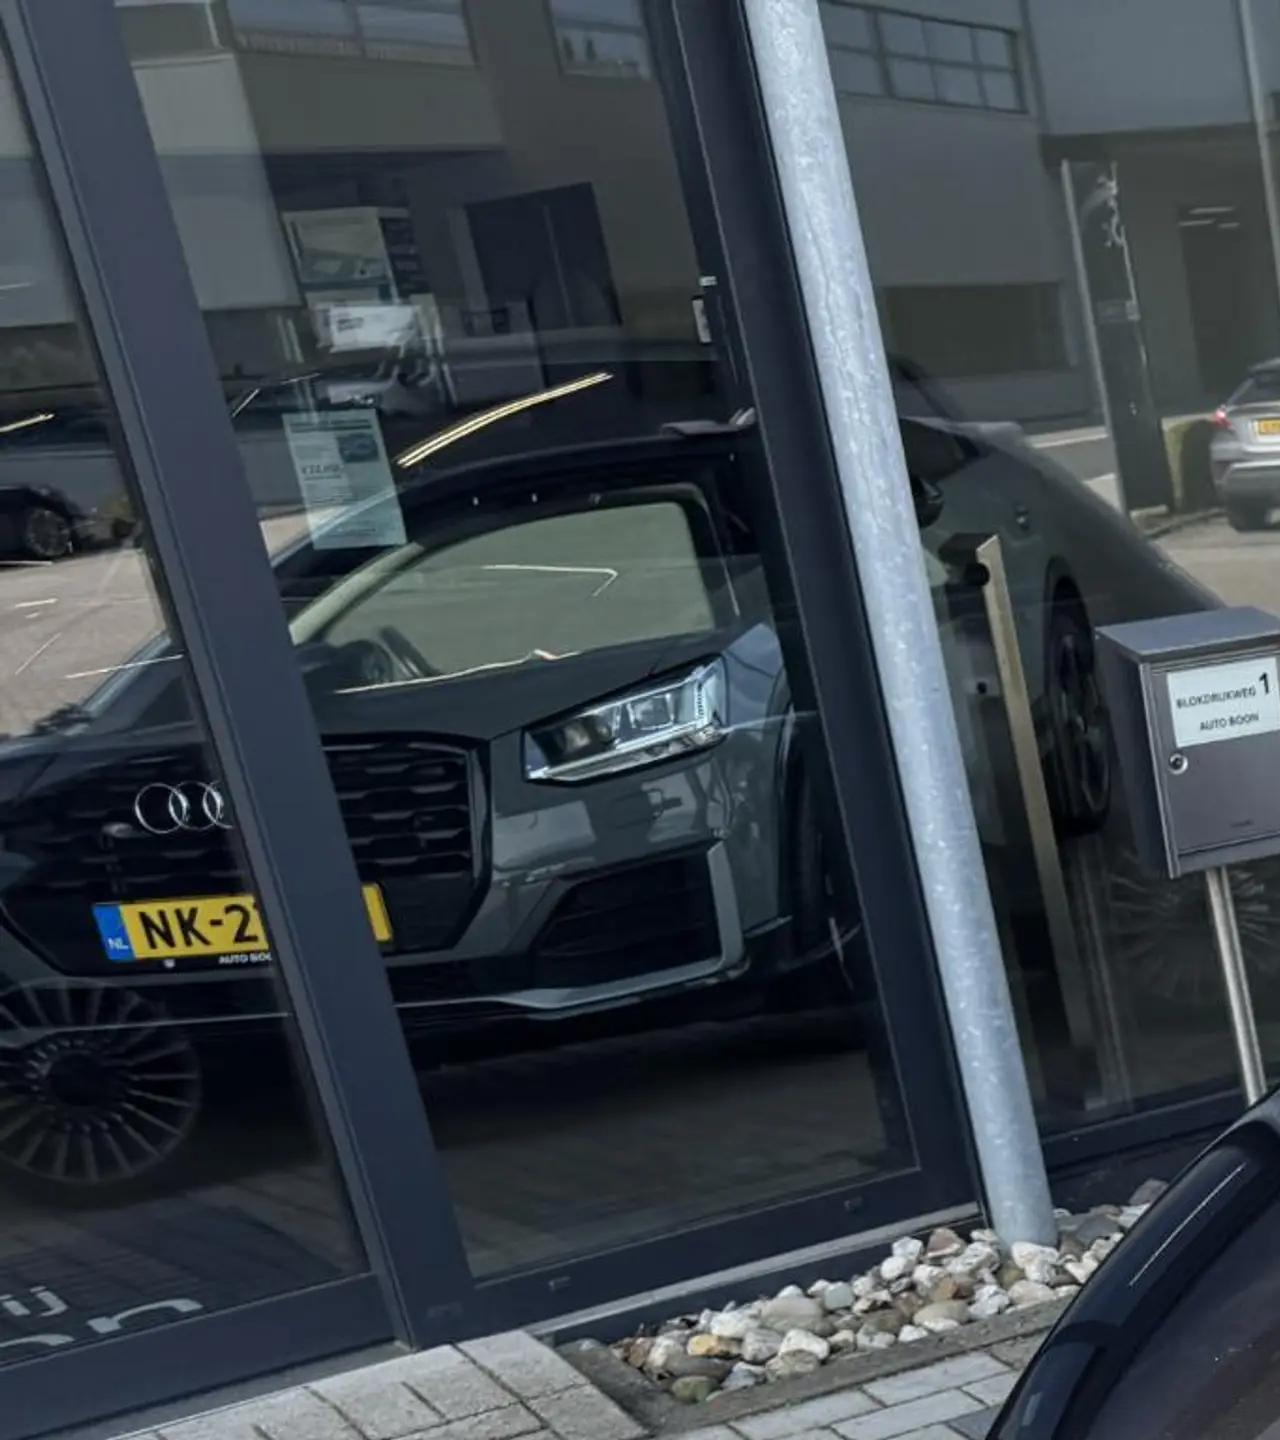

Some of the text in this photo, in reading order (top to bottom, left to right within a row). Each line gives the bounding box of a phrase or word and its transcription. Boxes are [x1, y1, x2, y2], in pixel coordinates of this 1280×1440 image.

[1259, 672, 1269, 694] 1
[1200, 713, 1260, 731] AUTO BOON
[139, 904, 258, 950] NK-2
[108, 937, 128, 951] NL
